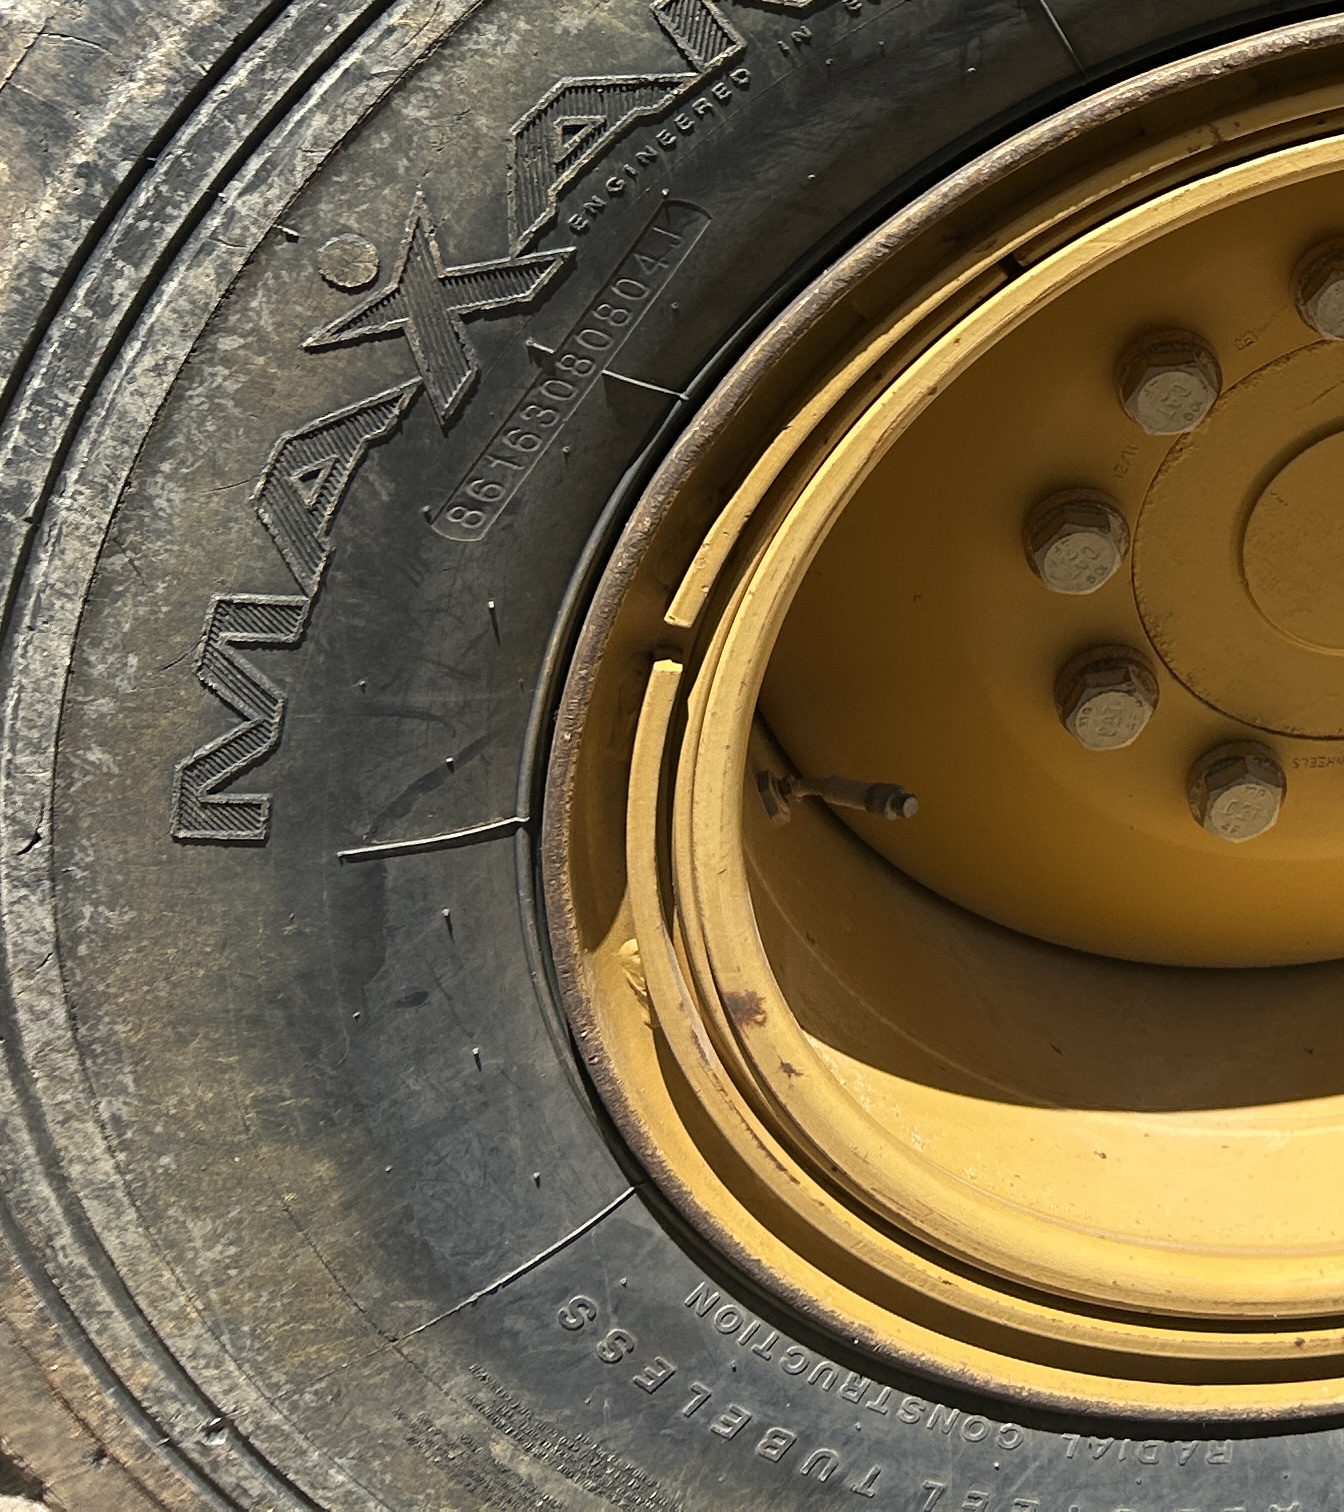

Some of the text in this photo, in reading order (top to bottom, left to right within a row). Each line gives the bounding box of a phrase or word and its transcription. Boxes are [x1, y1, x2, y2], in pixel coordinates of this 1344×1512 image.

[568, 64, 754, 234] ENGINEERED
[777, 23, 813, 60] IN
[557, 1293, 883, 1500] TUBELESS
[683, 1280, 1024, 1452] CONSTRUCTION
